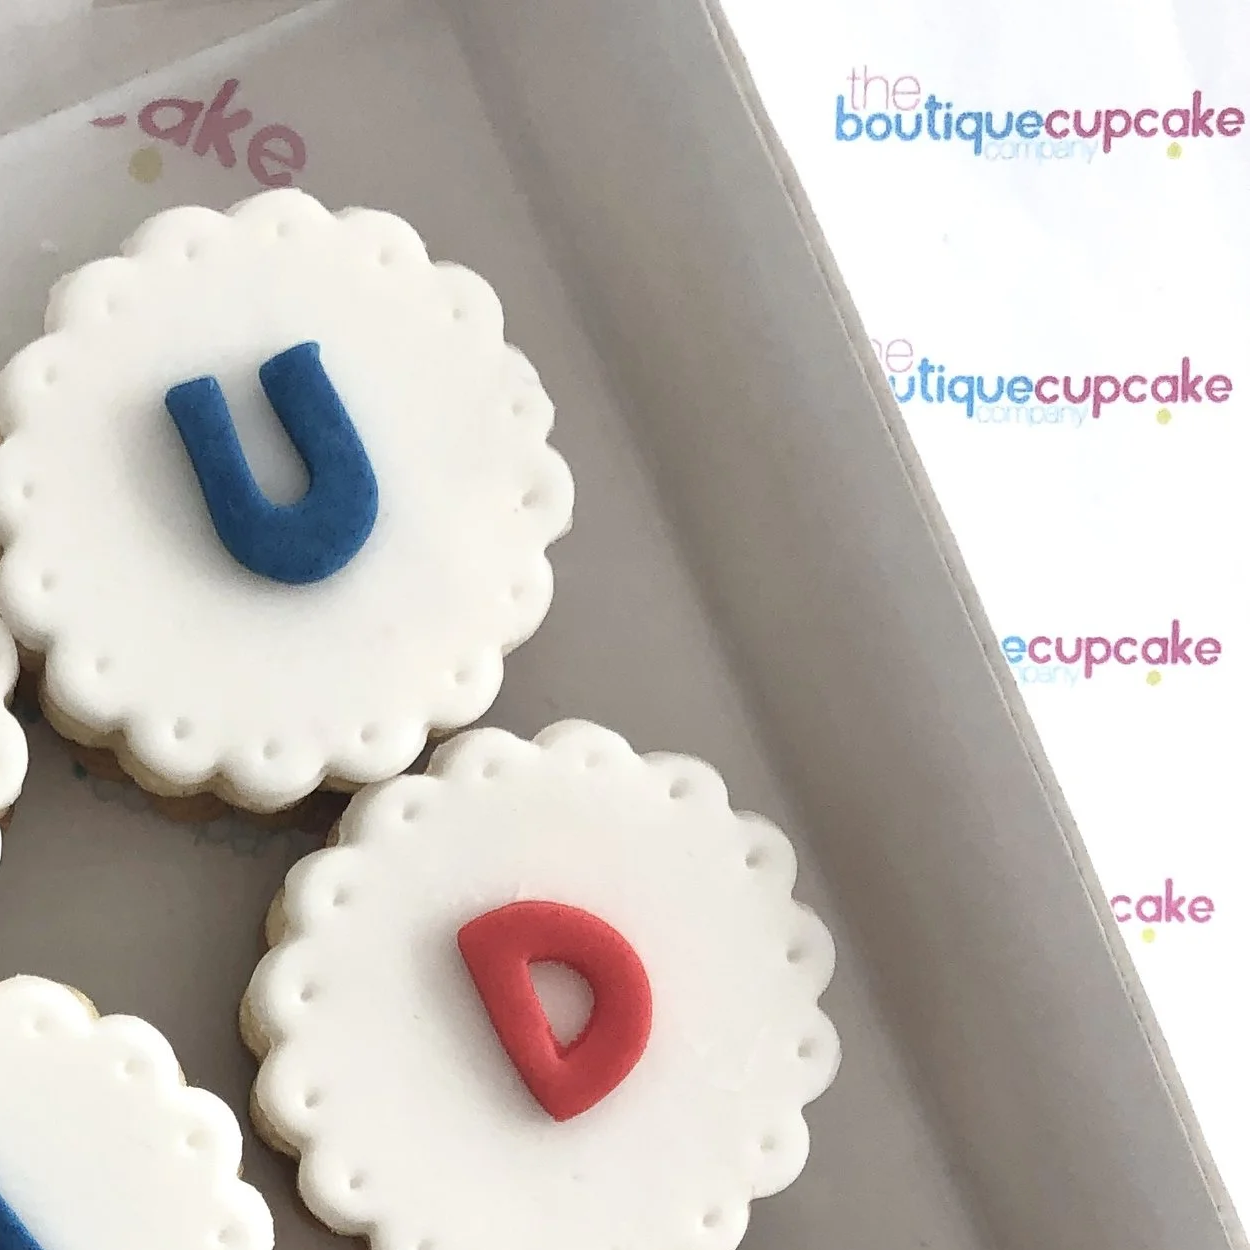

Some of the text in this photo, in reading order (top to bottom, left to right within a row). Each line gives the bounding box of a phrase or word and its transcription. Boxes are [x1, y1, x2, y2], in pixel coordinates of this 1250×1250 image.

[90, 78, 307, 188] ake
[847, 65, 921, 111] the
[984, 139, 1098, 163] company
[166, 342, 378, 585] U
[458, 901, 653, 1122] D
